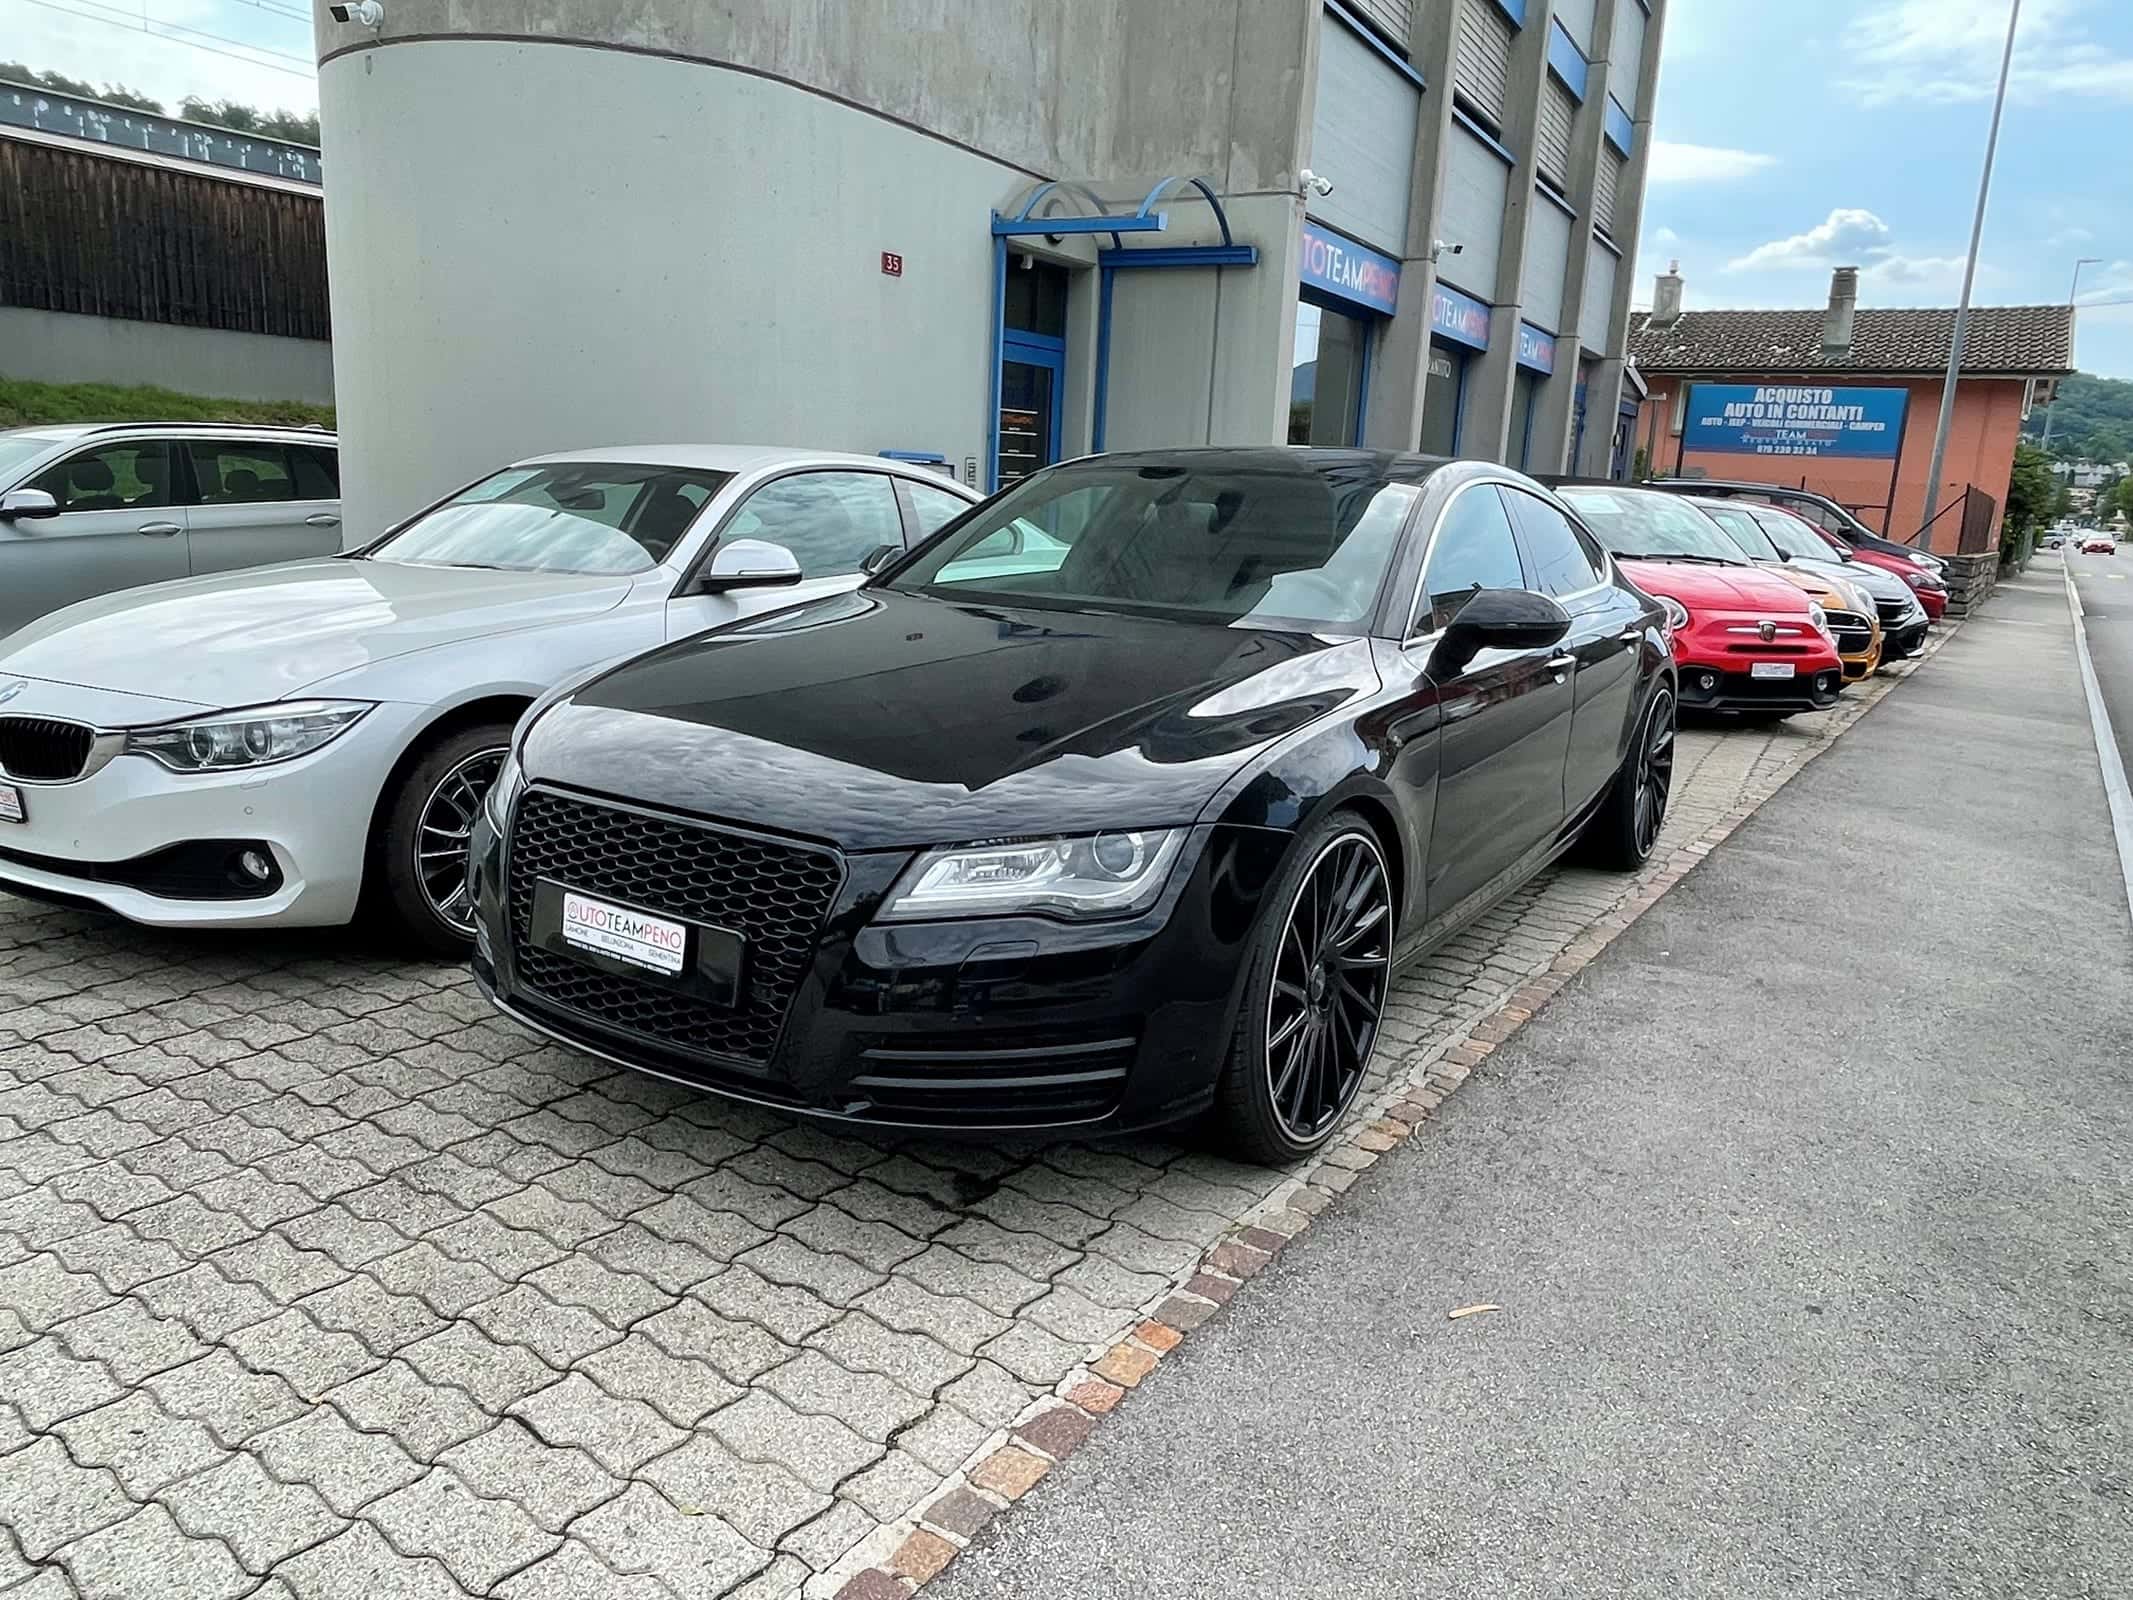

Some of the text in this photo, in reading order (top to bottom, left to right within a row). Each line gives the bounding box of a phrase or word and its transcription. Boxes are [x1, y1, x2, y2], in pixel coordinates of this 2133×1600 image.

[886, 255, 899, 271] 35
[1754, 388, 1833, 404] ACQUISTO
[1724, 402, 1864, 421] AUTO IN CONTANTI
